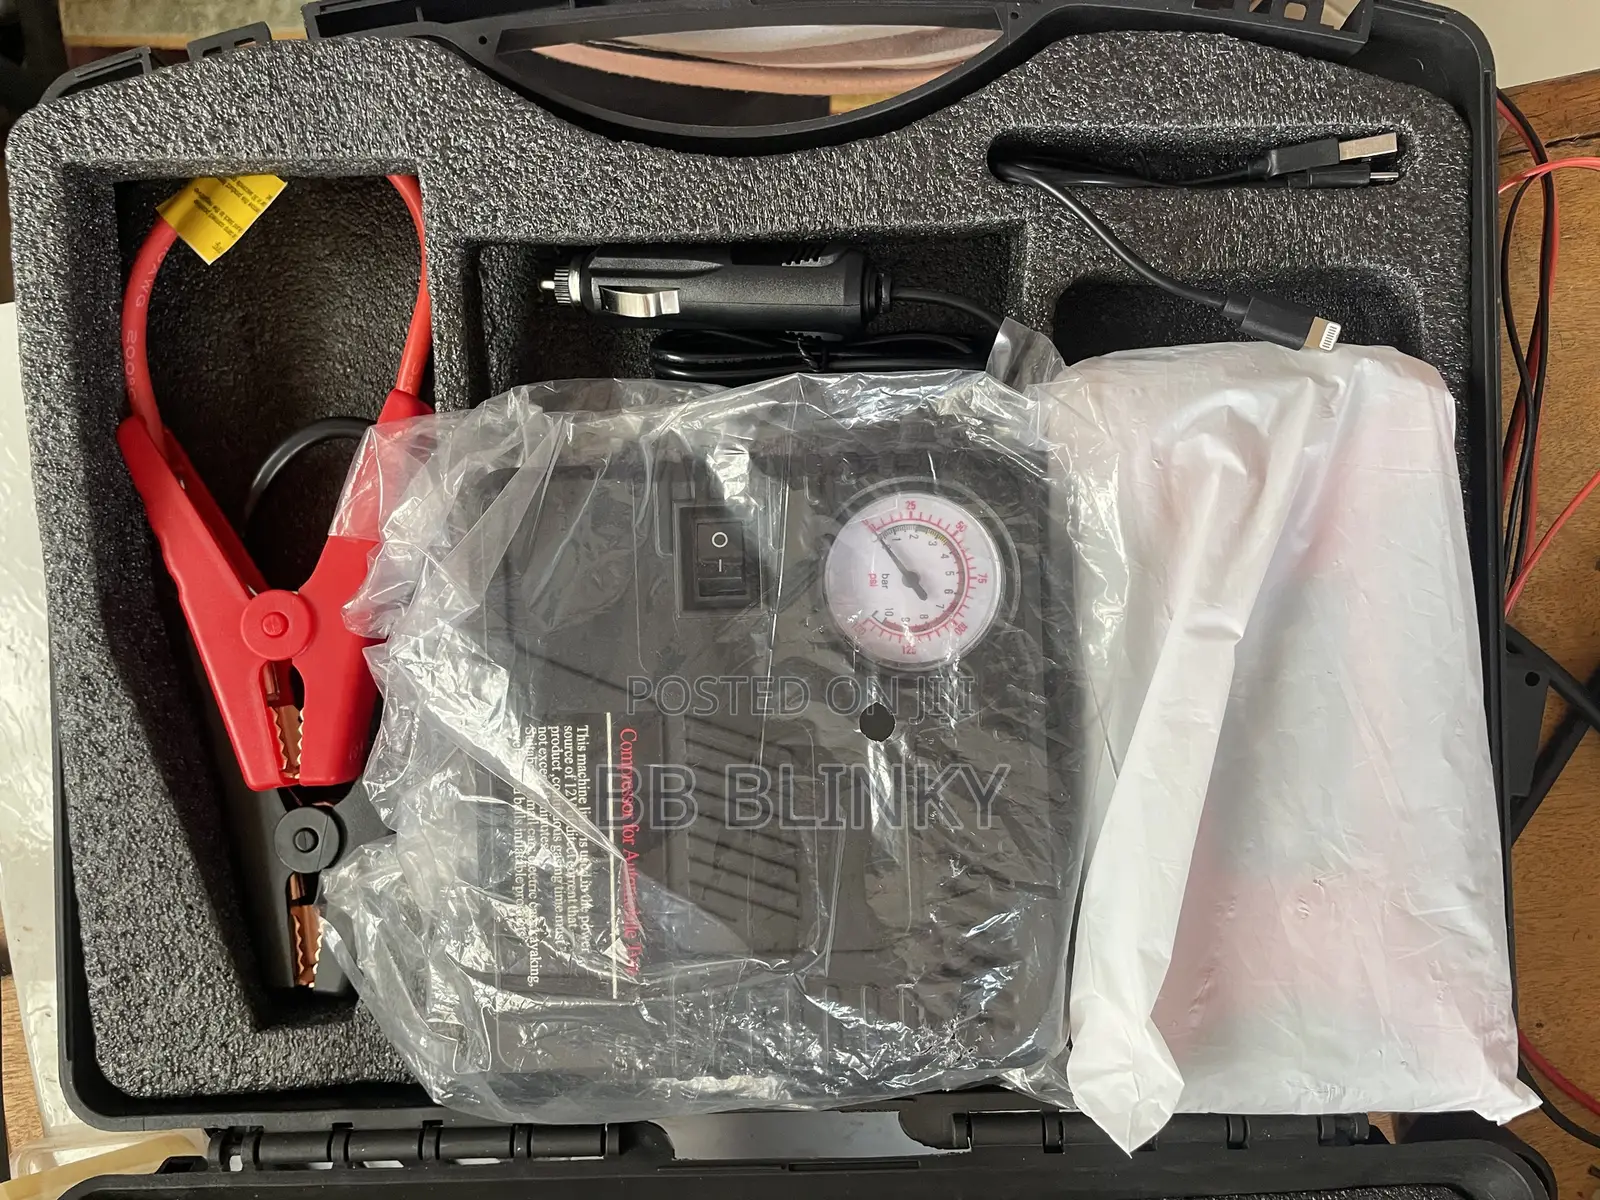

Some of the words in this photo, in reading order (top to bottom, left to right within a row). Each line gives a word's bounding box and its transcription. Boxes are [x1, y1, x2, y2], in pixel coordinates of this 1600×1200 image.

[905, 501, 916, 510] 25
[956, 521, 967, 533] 50
[868, 573, 878, 587] psi
[881, 573, 890, 589] bar
[978, 572, 988, 584] 75
[885, 608, 894, 617] 10
[538, 726, 548, 745] not
[564, 725, 574, 764] source
[577, 725, 590, 751] This
[548, 726, 563, 771] product
[565, 766, 577, 780] of
[578, 754, 592, 804] machine
[618, 728, 638, 818] Compressor
[622, 824, 640, 846] for
[554, 886, 566, 913] time
[568, 905, 579, 928] that
[578, 915, 591, 953] power
[527, 928, 542, 987] kayaking,
